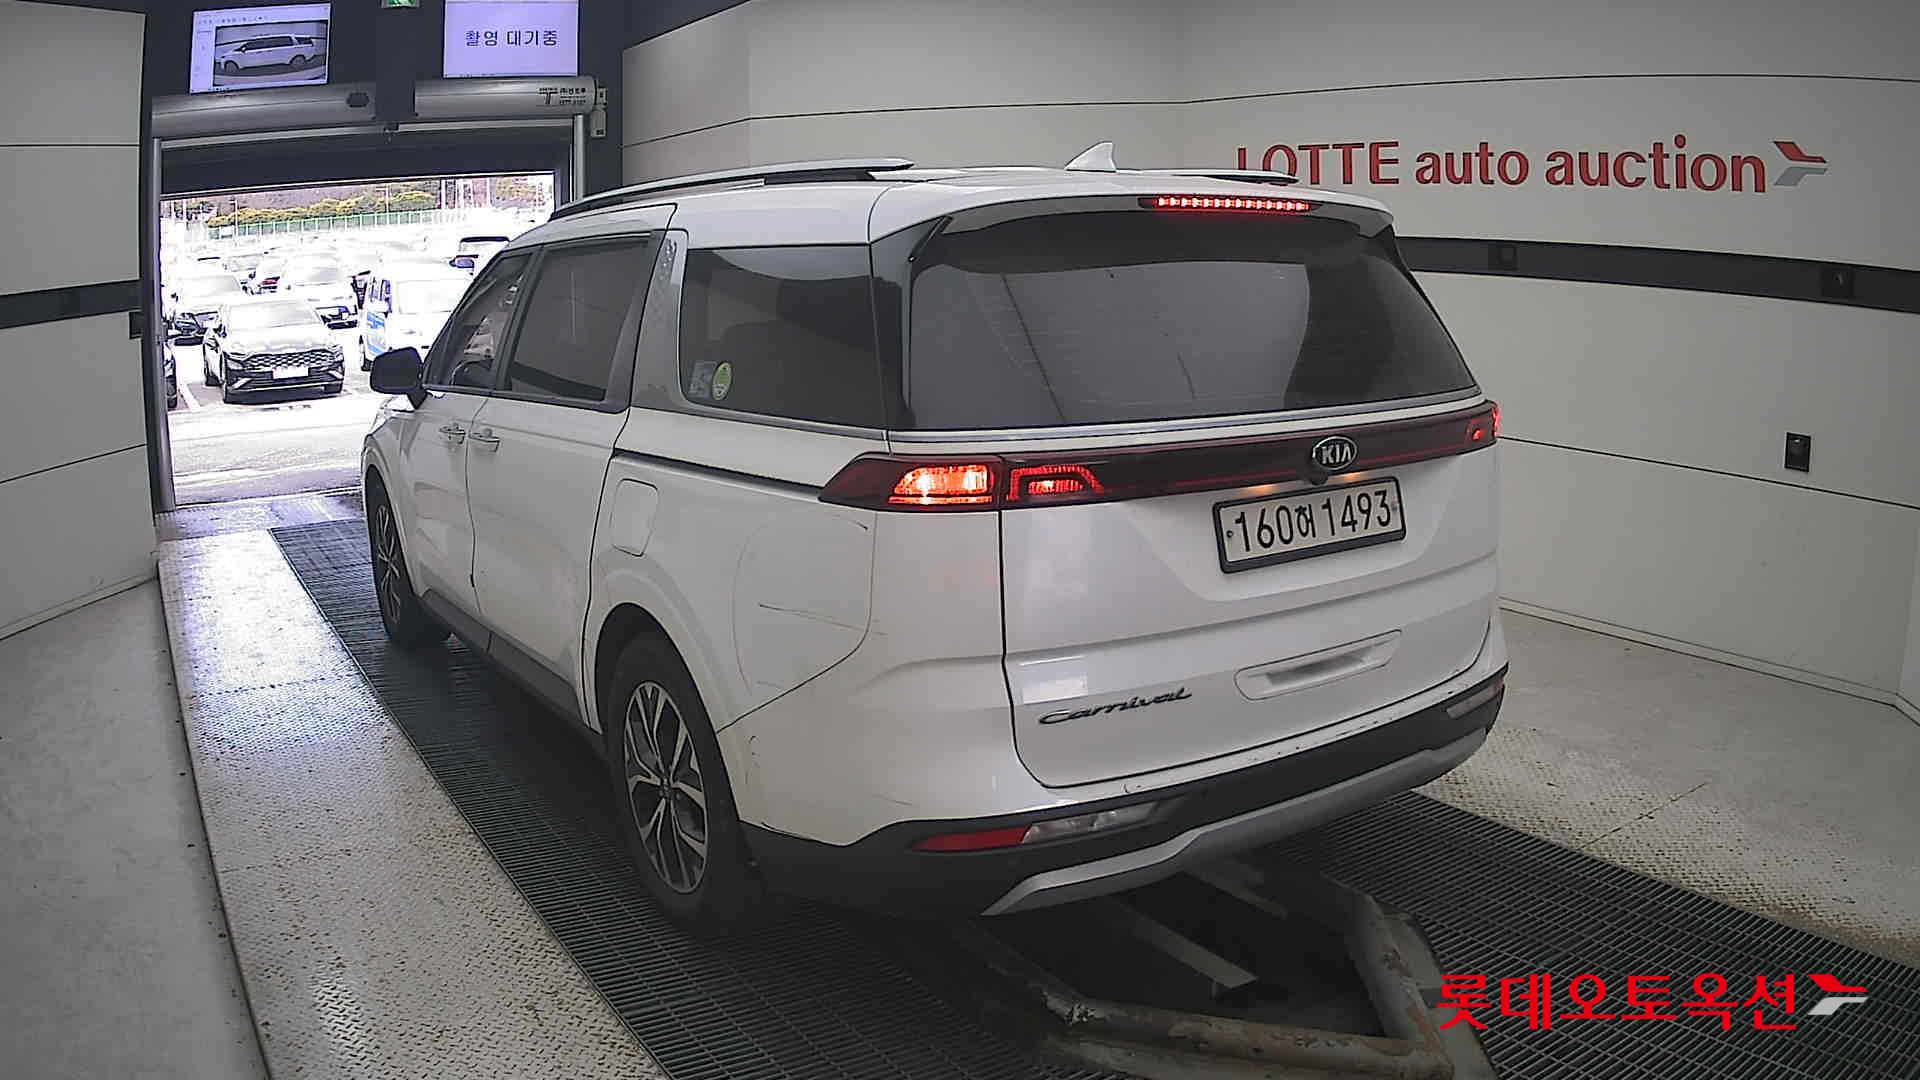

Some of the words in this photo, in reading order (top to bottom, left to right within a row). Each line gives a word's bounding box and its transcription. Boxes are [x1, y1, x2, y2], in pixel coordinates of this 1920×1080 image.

[465, 29, 498, 47] 촬영
[1415, 141, 1529, 187] auto
[1545, 134, 1767, 193] auction
[1321, 443, 1351, 465] KIA
[1038, 687, 1193, 725] Carnival
